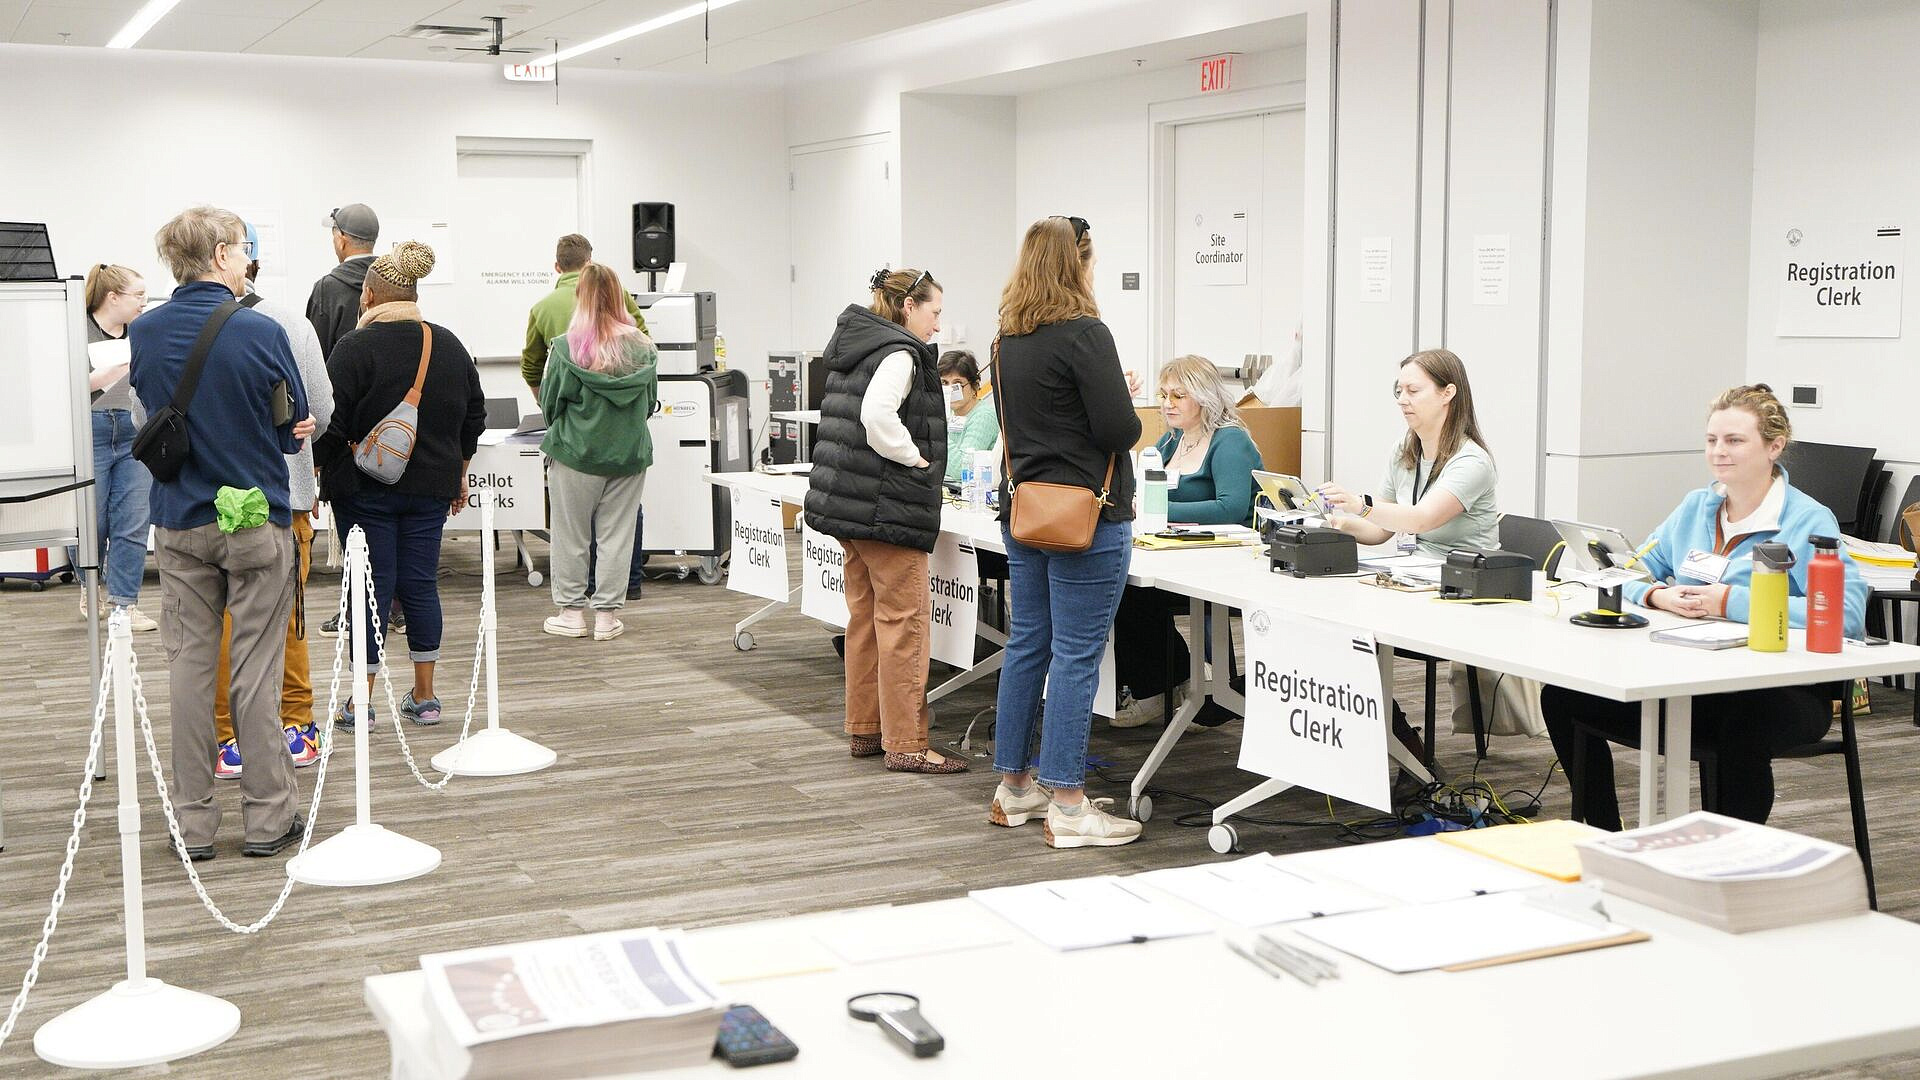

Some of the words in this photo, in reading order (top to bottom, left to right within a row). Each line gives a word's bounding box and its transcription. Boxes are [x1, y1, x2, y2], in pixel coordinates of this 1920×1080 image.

[1201, 57, 1226, 91] EXIT
[1210, 233, 1226, 247] Site
[1195, 250, 1243, 264] Coordinator
[1788, 260, 1895, 286] Registration
[1816, 286, 1862, 306] Clerk
[468, 473, 513, 488] Ballot
[467, 493, 514, 508] Clrks
[735, 520, 783, 547] Registration
[748, 547, 770, 568] Clerk
[806, 540, 845, 567] Registra
[821, 570, 845, 594] Clerk
[928, 570, 974, 603] stration
[930, 600, 952, 628] lerk
[1255, 660, 1377, 721] Registration
[1289, 708, 1343, 749] Clerk
